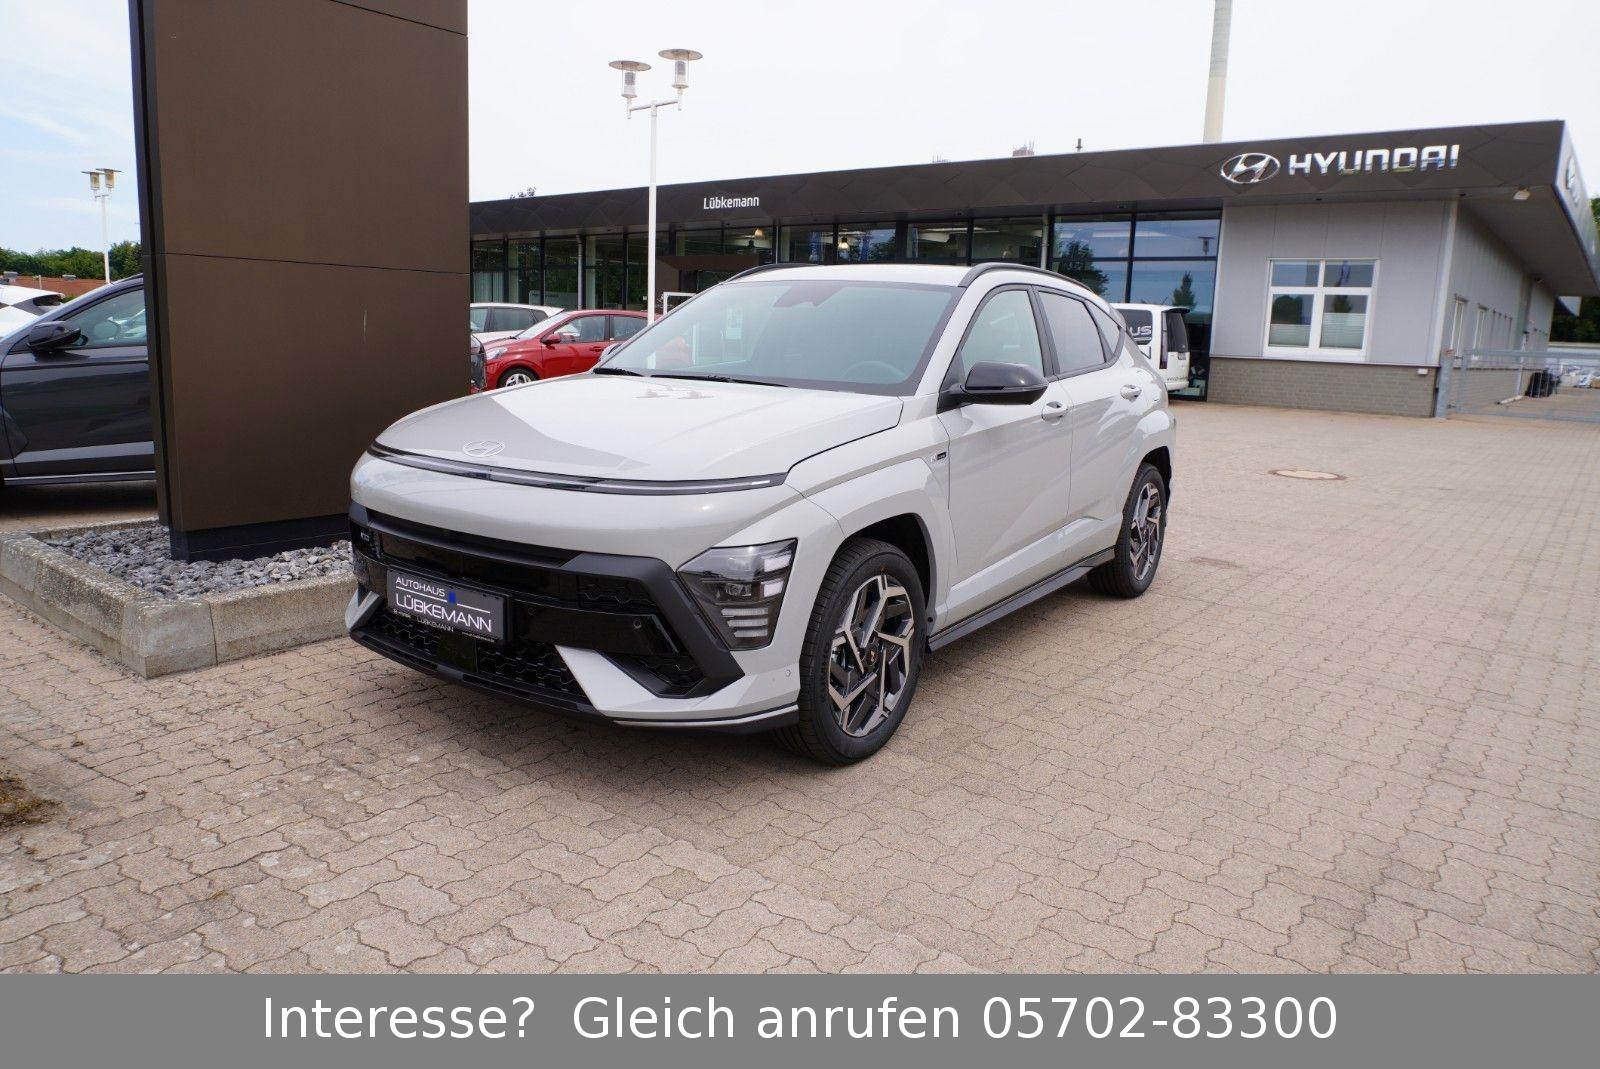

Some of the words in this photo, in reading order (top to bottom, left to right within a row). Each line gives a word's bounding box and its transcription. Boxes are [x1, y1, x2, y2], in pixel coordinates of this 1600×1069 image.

[1288, 144, 1460, 176] HYUNDAI
[703, 196, 760, 210] Lübkemann
[395, 577, 446, 597] AUTOHAUS
[395, 593, 492, 632] LÜBKEMANN
